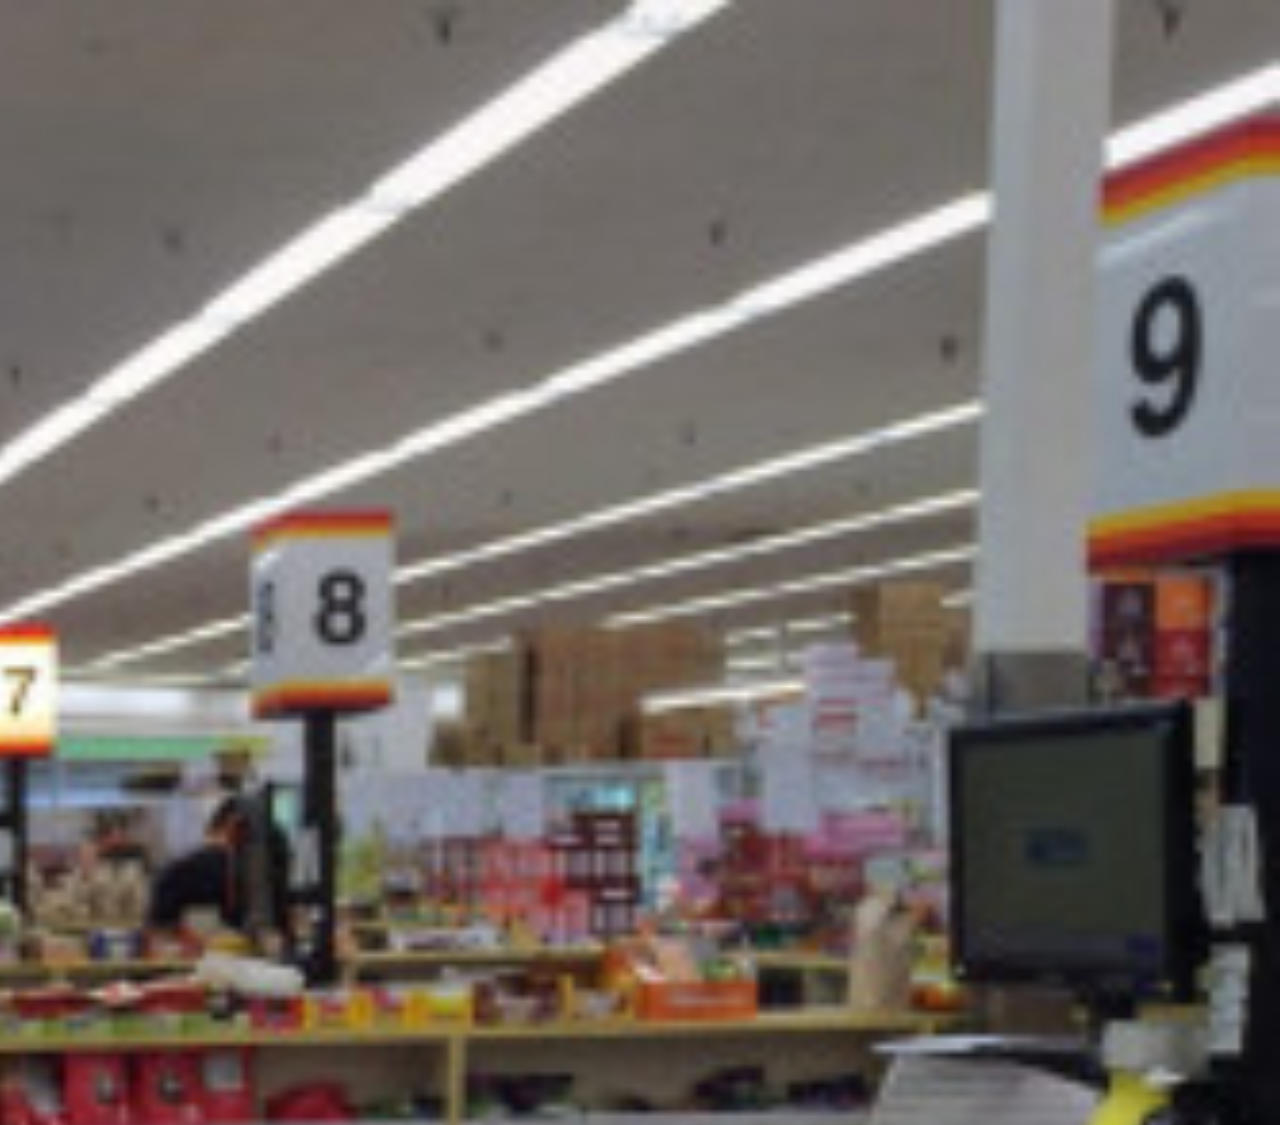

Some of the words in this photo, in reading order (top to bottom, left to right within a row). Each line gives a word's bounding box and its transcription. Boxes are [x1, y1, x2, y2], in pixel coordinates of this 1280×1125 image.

[1130, 274, 1204, 437] 9
[313, 569, 366, 648] 8
[2, 665, 37, 715] 7
